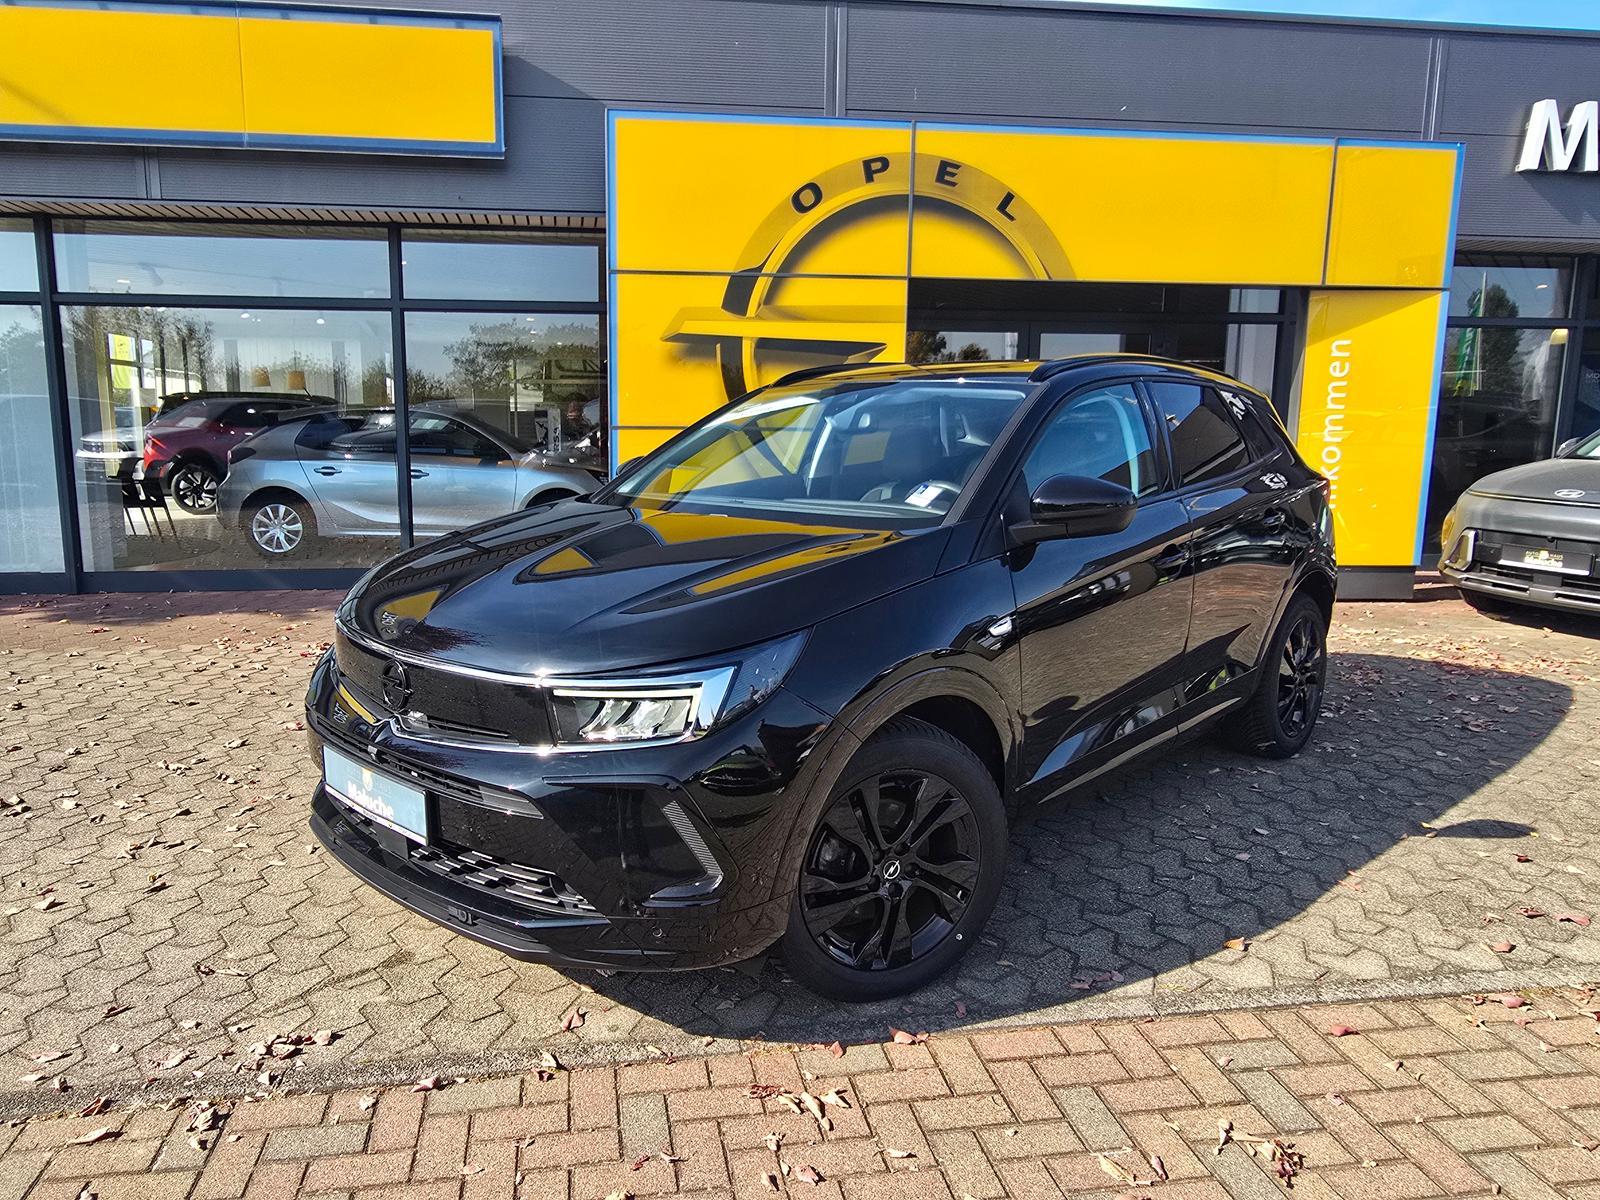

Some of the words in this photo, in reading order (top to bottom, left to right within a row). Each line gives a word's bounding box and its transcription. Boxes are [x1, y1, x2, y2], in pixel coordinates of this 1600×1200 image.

[1515, 98, 1599, 172] M
[791, 156, 1017, 222] OPEL
[1320, 338, 1352, 509] kommen
